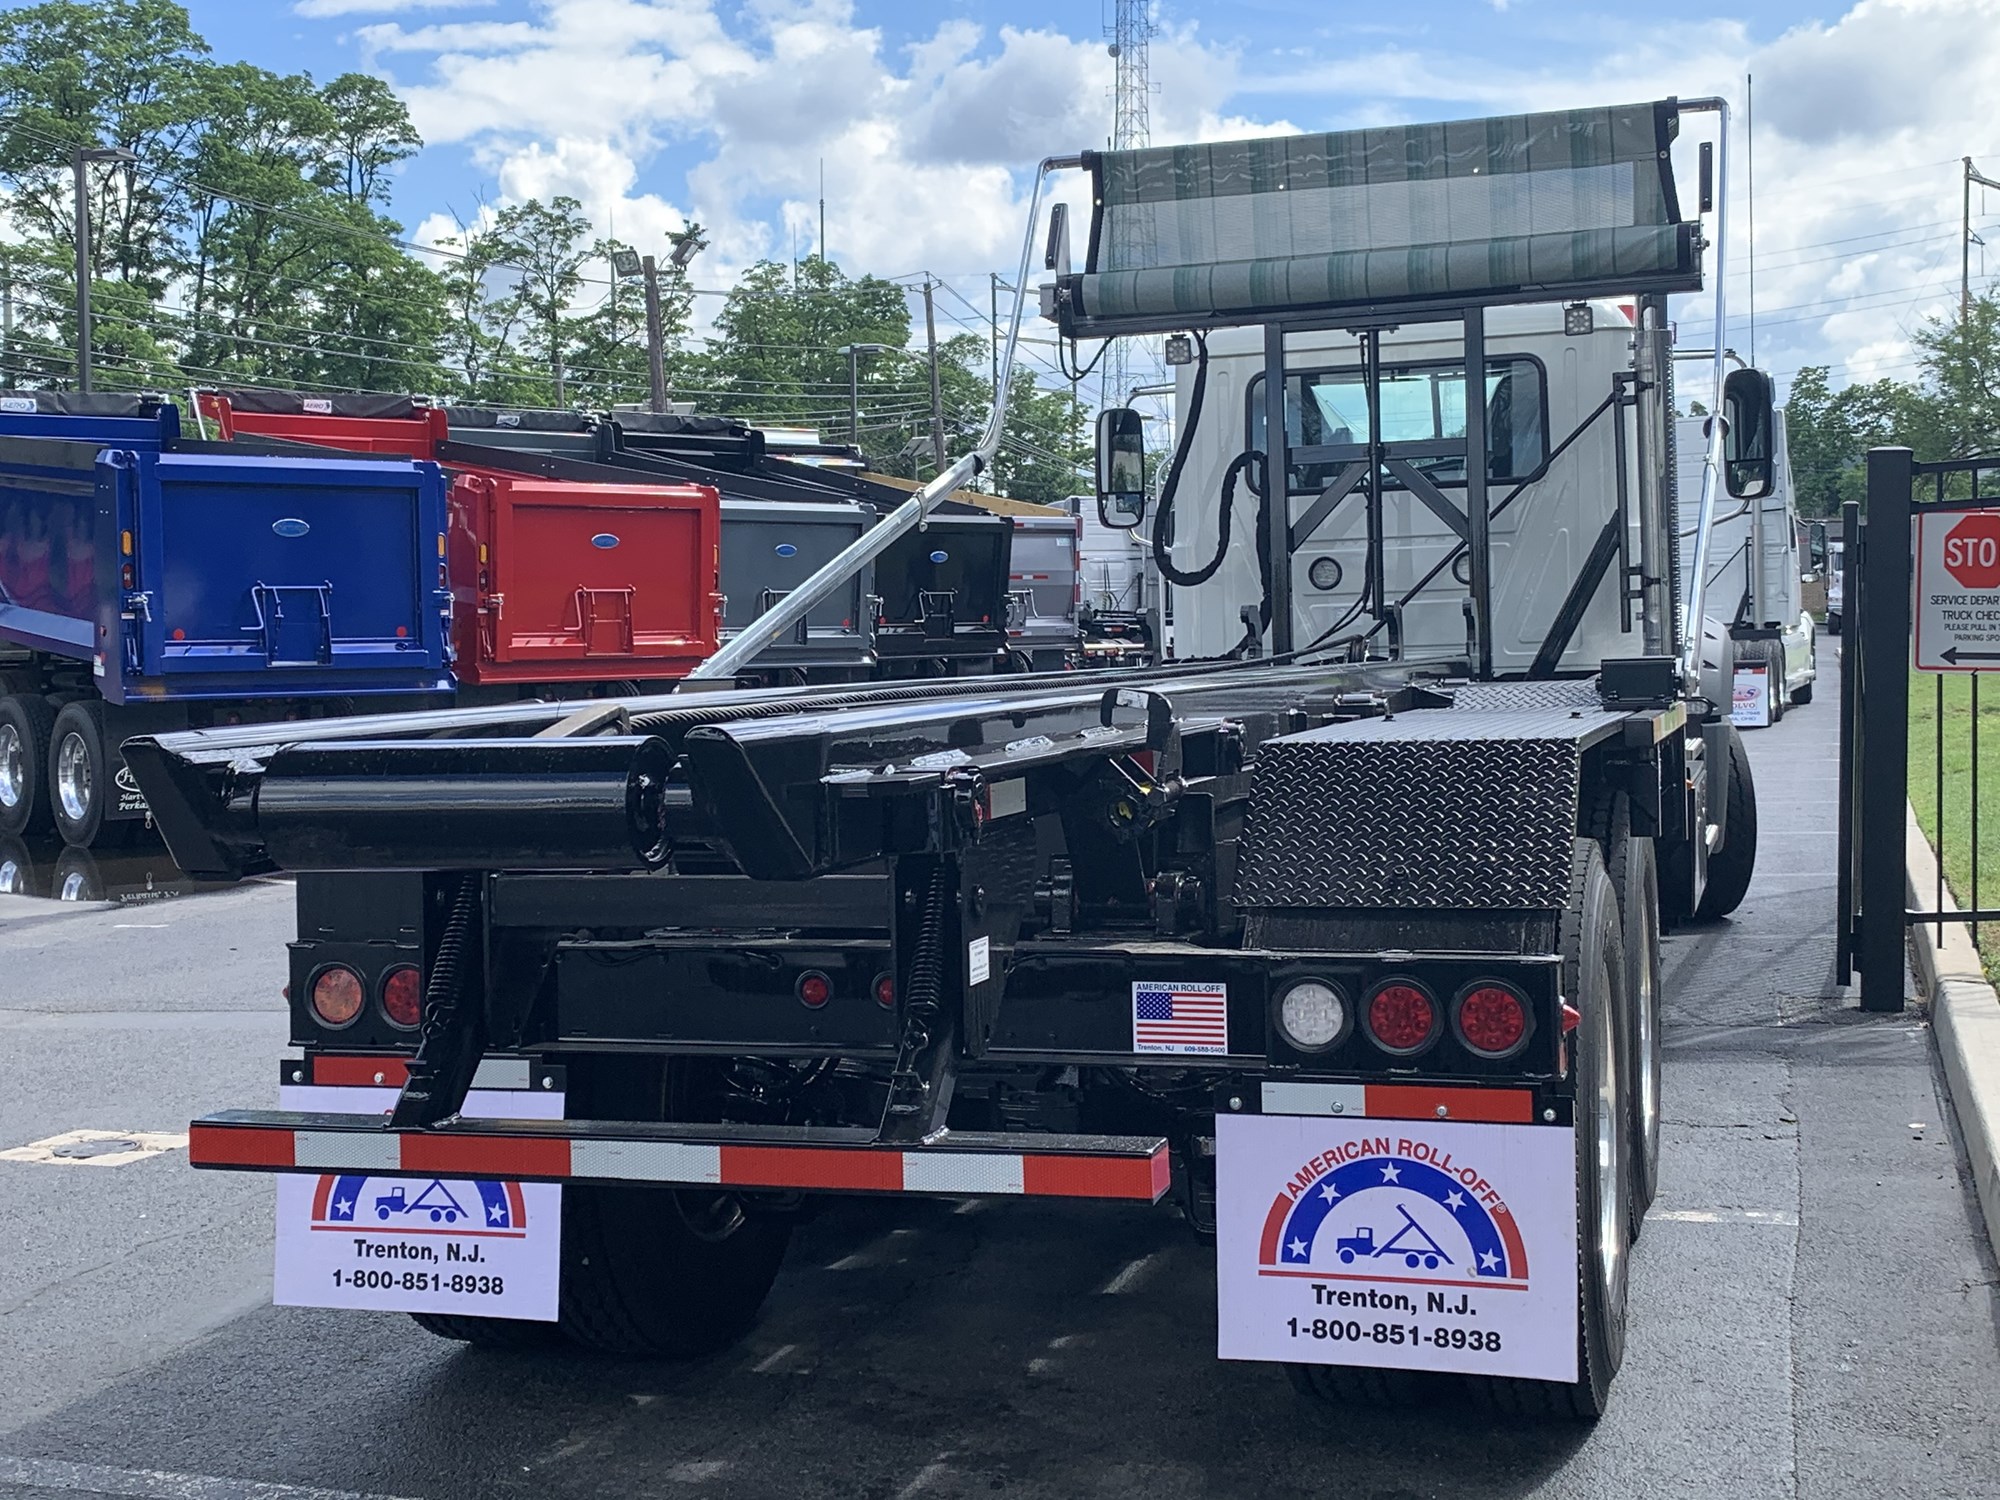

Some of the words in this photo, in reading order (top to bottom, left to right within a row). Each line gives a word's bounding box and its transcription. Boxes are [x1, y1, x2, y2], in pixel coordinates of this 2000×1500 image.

[1946, 537, 1996, 567] STO
[1930, 595, 1968, 605] SERVICE
[1970, 595, 2000, 605] DEPAR
[1942, 610, 1973, 620] TRUCK
[1975, 610, 2000, 620] CHEC
[1944, 623, 1969, 631] PLEASE
[1970, 623, 1987, 631] PULL
[1989, 623, 1996, 631] IN
[1136, 983, 1179, 992] AMERICAN
[1138, 1044, 1164, 1052] Trenton,
[1286, 1137, 1391, 1199] AMERICAN
[354, 1239, 438, 1264] Trenton,
[446, 1243, 486, 1263] N.J.
[332, 1269, 504, 1295] 1-800-851-8938
[1311, 1284, 1417, 1316] Trenton,
[1427, 1291, 1477, 1316] N.J.
[1287, 1317, 1502, 1352] 1-800-851-8938
